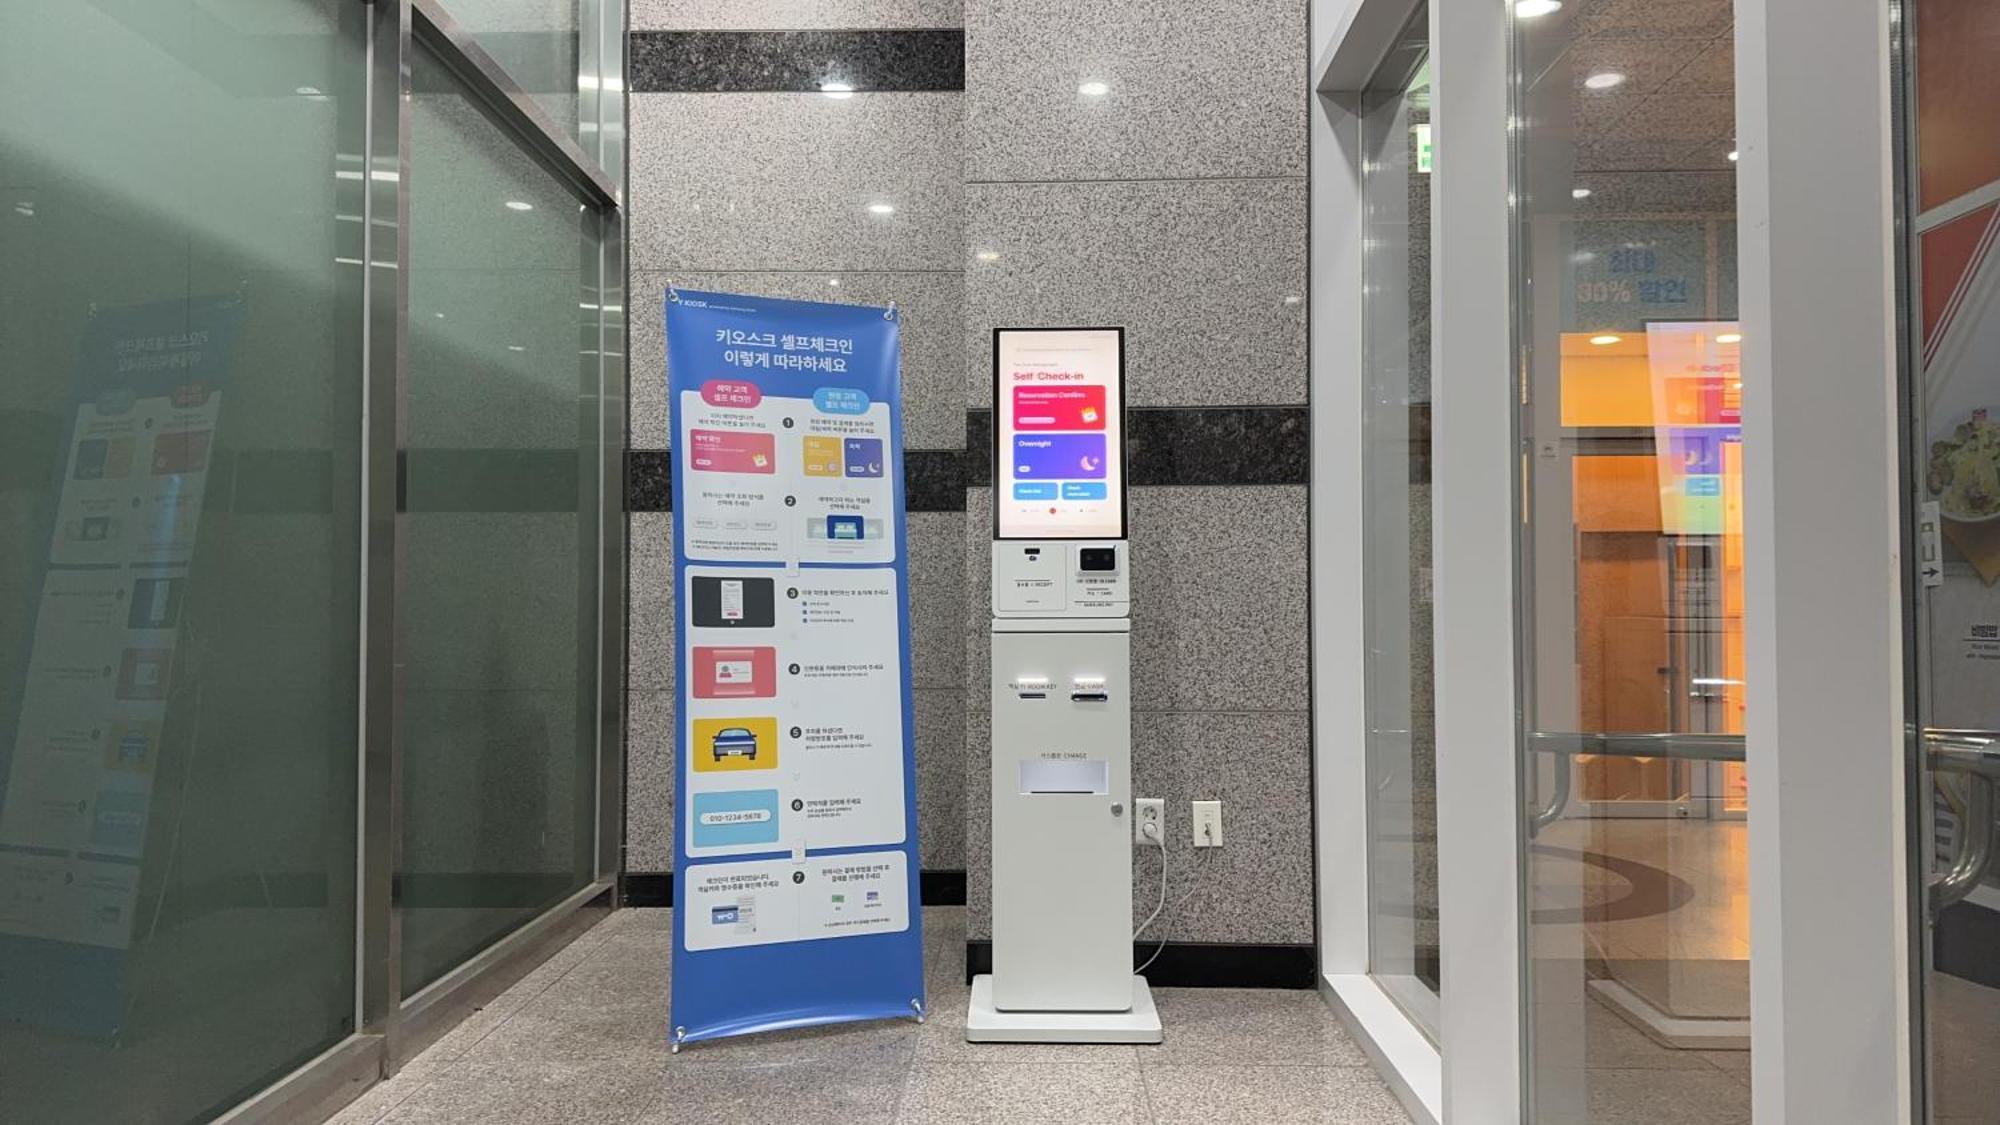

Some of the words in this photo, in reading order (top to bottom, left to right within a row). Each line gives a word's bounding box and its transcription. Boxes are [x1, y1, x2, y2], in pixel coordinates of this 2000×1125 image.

[715, 329, 777, 348] 키오스크
[780, 333, 853, 355] 셀프체크인
[724, 350, 770, 369] 이렇게
[774, 354, 848, 373] 따라하세요
[1013, 372, 1034, 381] Self
[1037, 371, 1085, 381] Check-in
[733, 385, 748, 394] 고객
[1018, 440, 1052, 448] Overnight
[1063, 752, 1088, 760] CHANGE
[709, 812, 762, 822] 010-1234-5678
